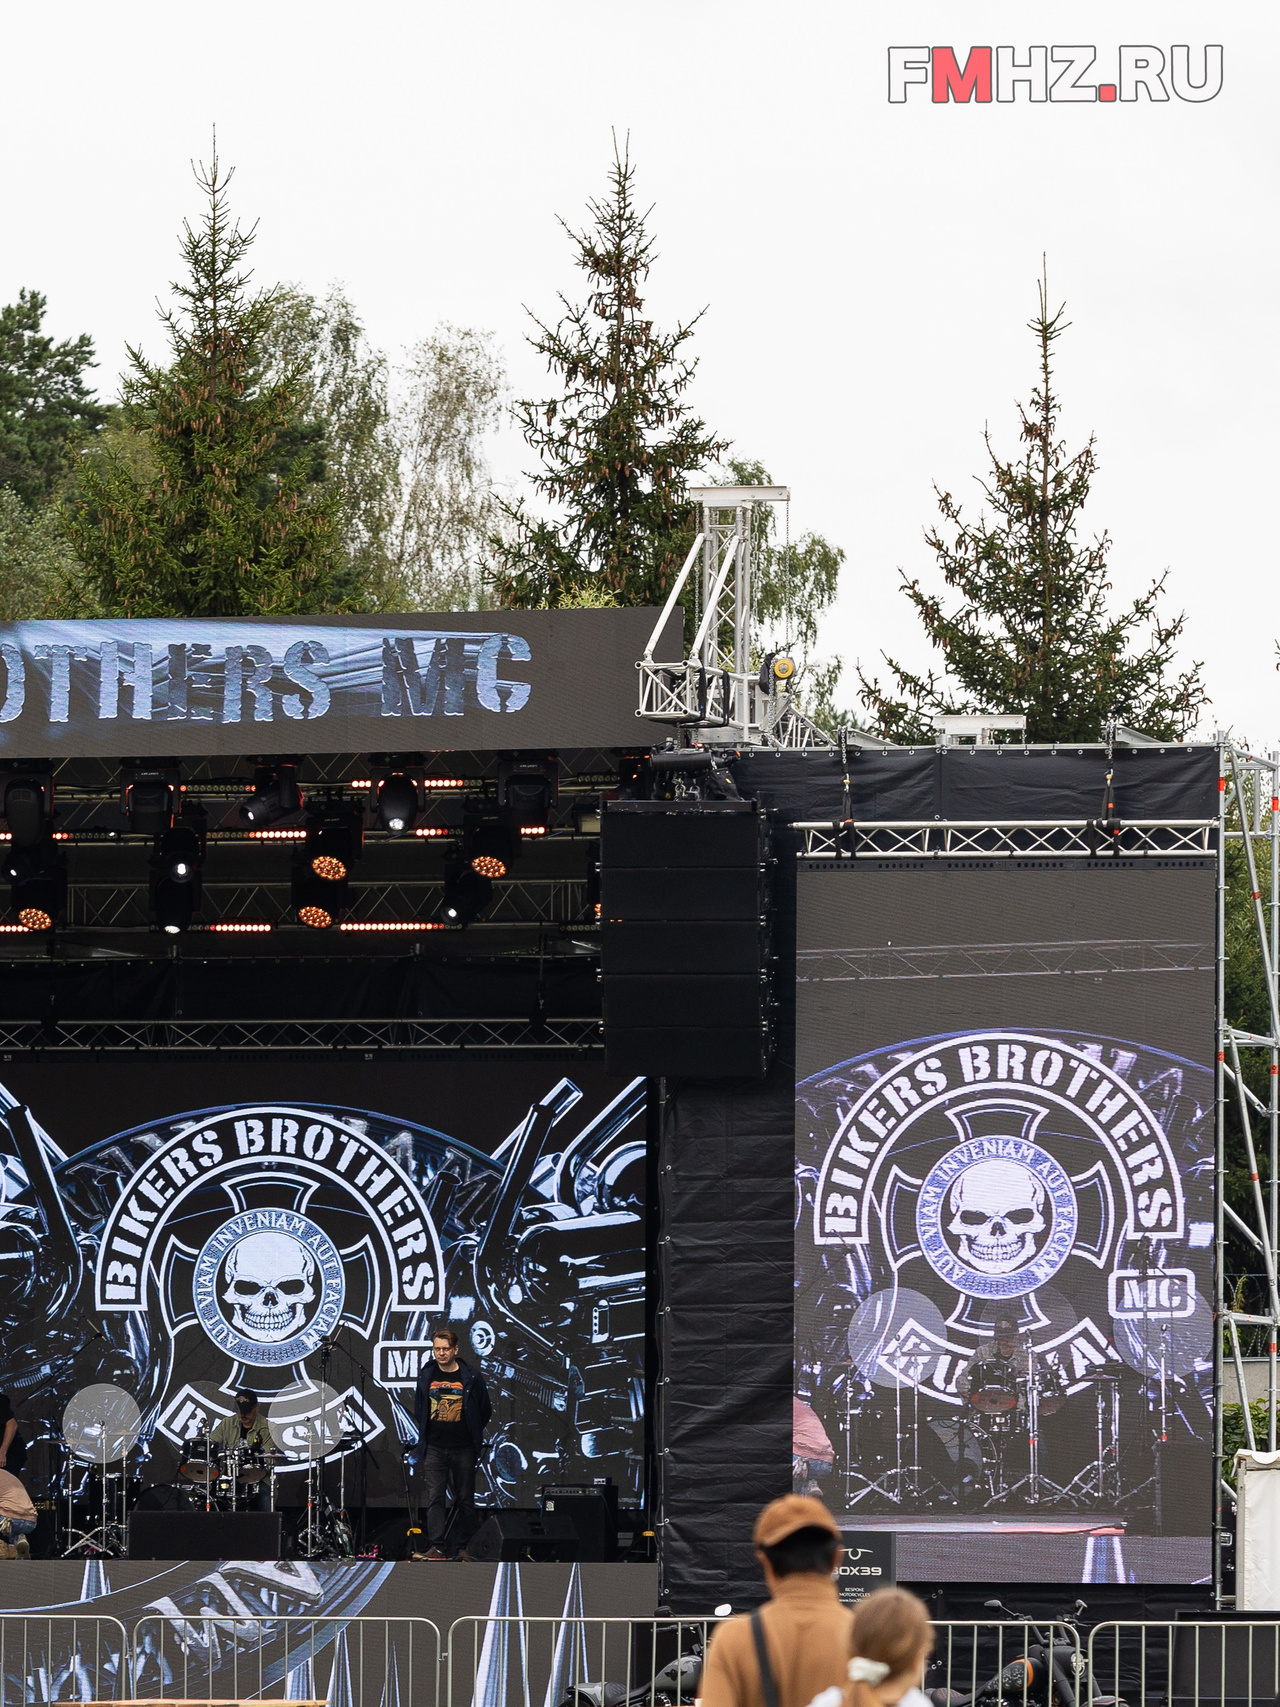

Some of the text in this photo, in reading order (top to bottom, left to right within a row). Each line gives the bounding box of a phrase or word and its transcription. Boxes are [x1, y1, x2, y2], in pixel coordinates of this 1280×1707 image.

[380, 633, 532, 717] MC
[825, 1044, 1174, 1234] BIKERS BROTHERS
[105, 1128, 224, 1300] BIKERS
[233, 1117, 435, 1300] BROTHERS
[929, 1247, 967, 1281] AUT
[1035, 1161, 1071, 1198] AUT
[197, 1254, 218, 1310] VIAM
[307, 1234, 341, 1270] AUT
[1123, 1278, 1182, 1308] MC
[204, 1314, 240, 1349] AUT
[169, 1399, 372, 1462] RSIA
